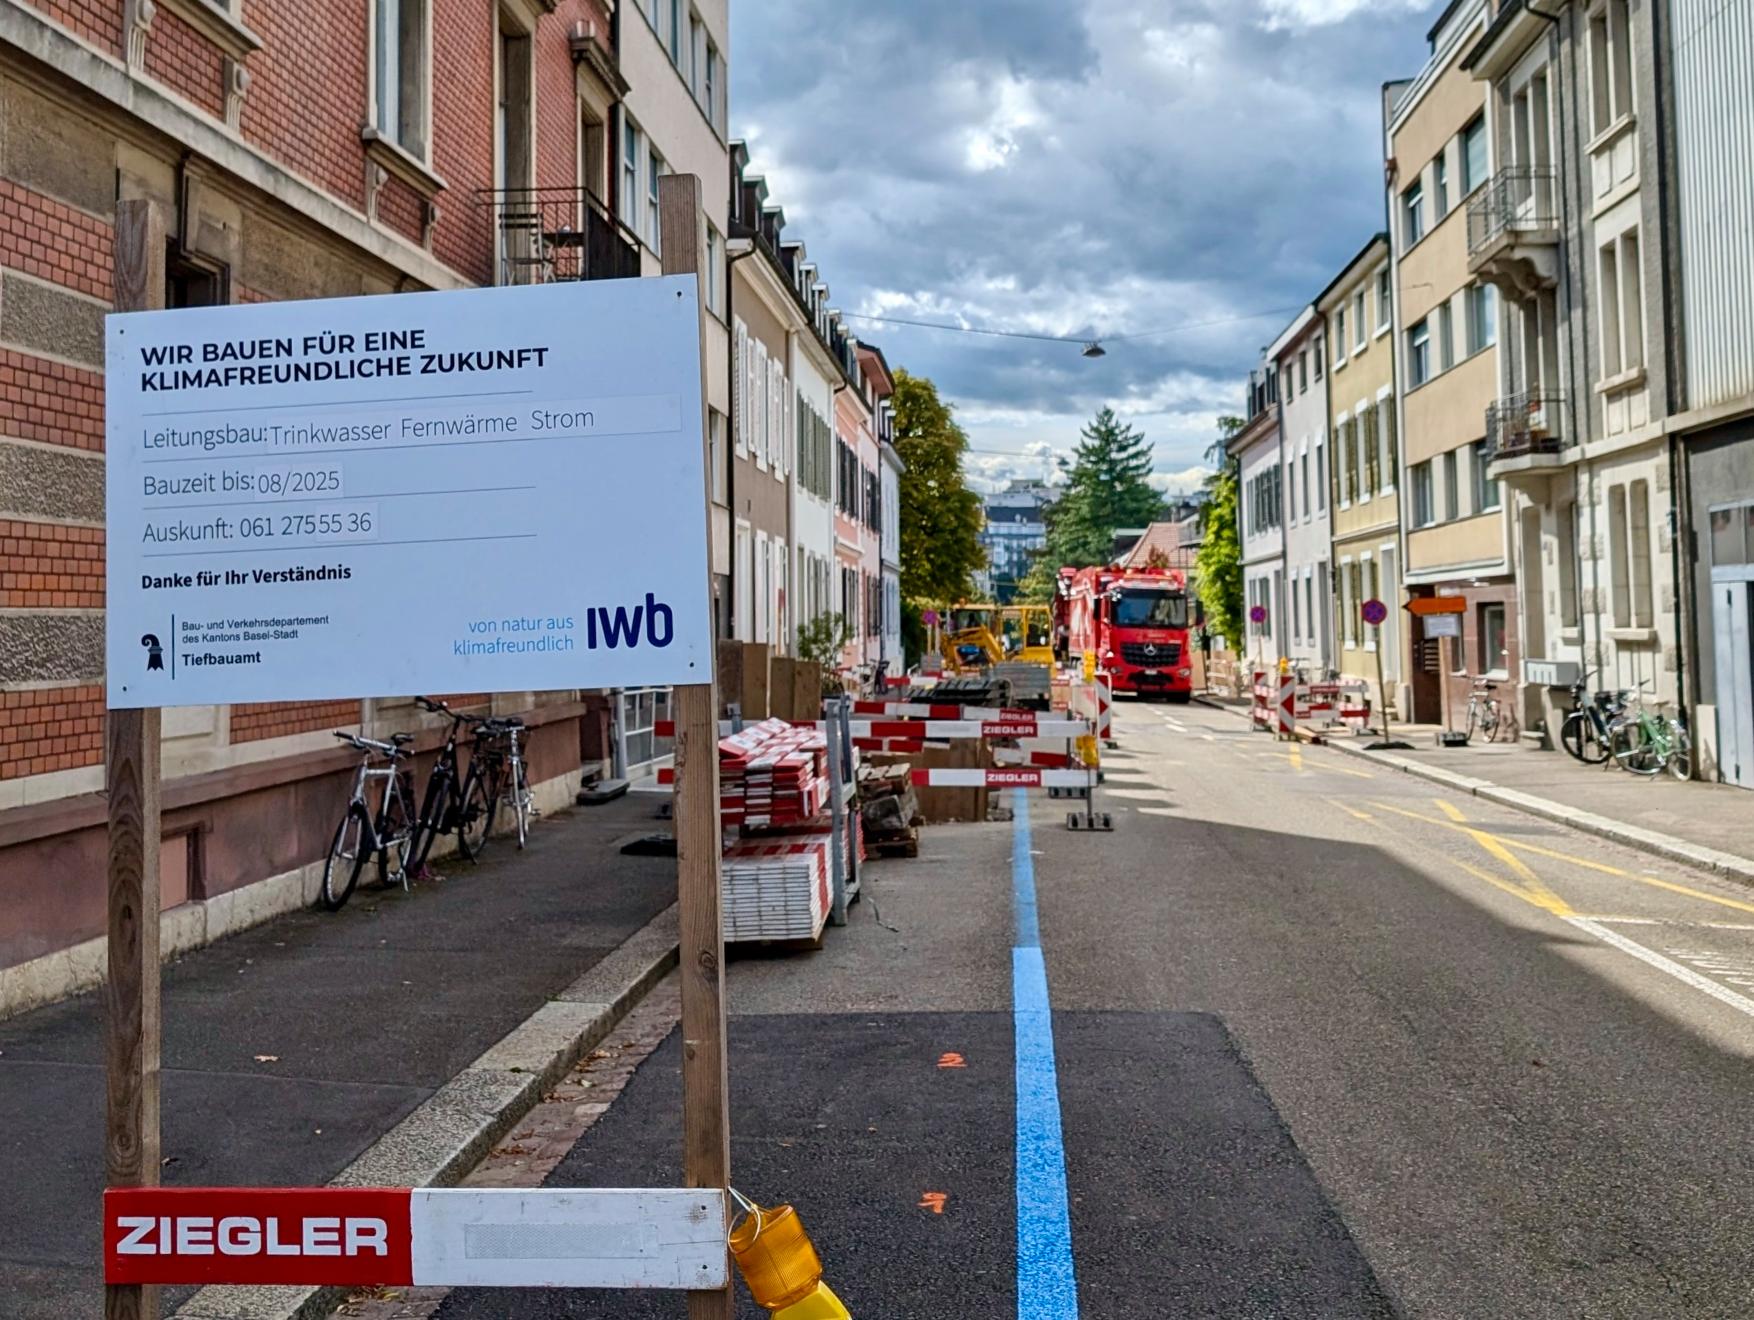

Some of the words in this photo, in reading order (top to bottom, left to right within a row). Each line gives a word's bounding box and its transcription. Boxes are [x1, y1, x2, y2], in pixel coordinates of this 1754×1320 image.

[140, 345, 193, 366] WIR
[202, 338, 292, 362] BAUEN
[302, 330, 354, 356] FÜR
[364, 329, 424, 351] EINE
[141, 355, 411, 392] KLIMAFREUNDLICHE
[419, 347, 549, 374] ZUKUNFT
[143, 424, 267, 451] Leitungsbau:
[269, 420, 391, 445] Trinkwasser
[401, 413, 517, 439] Fernwärme
[531, 408, 594, 430] Strom
[143, 475, 216, 496] Bauzeit
[222, 469, 254, 491] bis:
[258, 470, 340, 496] 08/2025
[142, 516, 233, 543] Auskunft:
[239, 516, 274, 537] 061
[347, 511, 371, 532] 36
[141, 573, 192, 589] Danke
[196, 569, 221, 587] für
[224, 568, 249, 585] Ihr
[252, 564, 351, 584] Verständnis
[181, 621, 204, 631] Bau-
[206, 619, 224, 630] und
[227, 614, 329, 629] Verkehrsdepartement
[468, 622, 496, 633] von
[501, 618, 540, 633] natur
[545, 617, 573, 631] aus
[181, 633, 200, 643] des
[202, 631, 240, 642] Kantons
[243, 628, 299, 640] Basel-Stadt
[452, 634, 573, 656] klimafreundlich
[181, 651, 261, 666] Tiefbauamt
[983, 725, 1034, 734] ZIEGLER
[987, 773, 1038, 783] ZIEGLER
[116, 1216, 389, 1256] ZIEGLER
